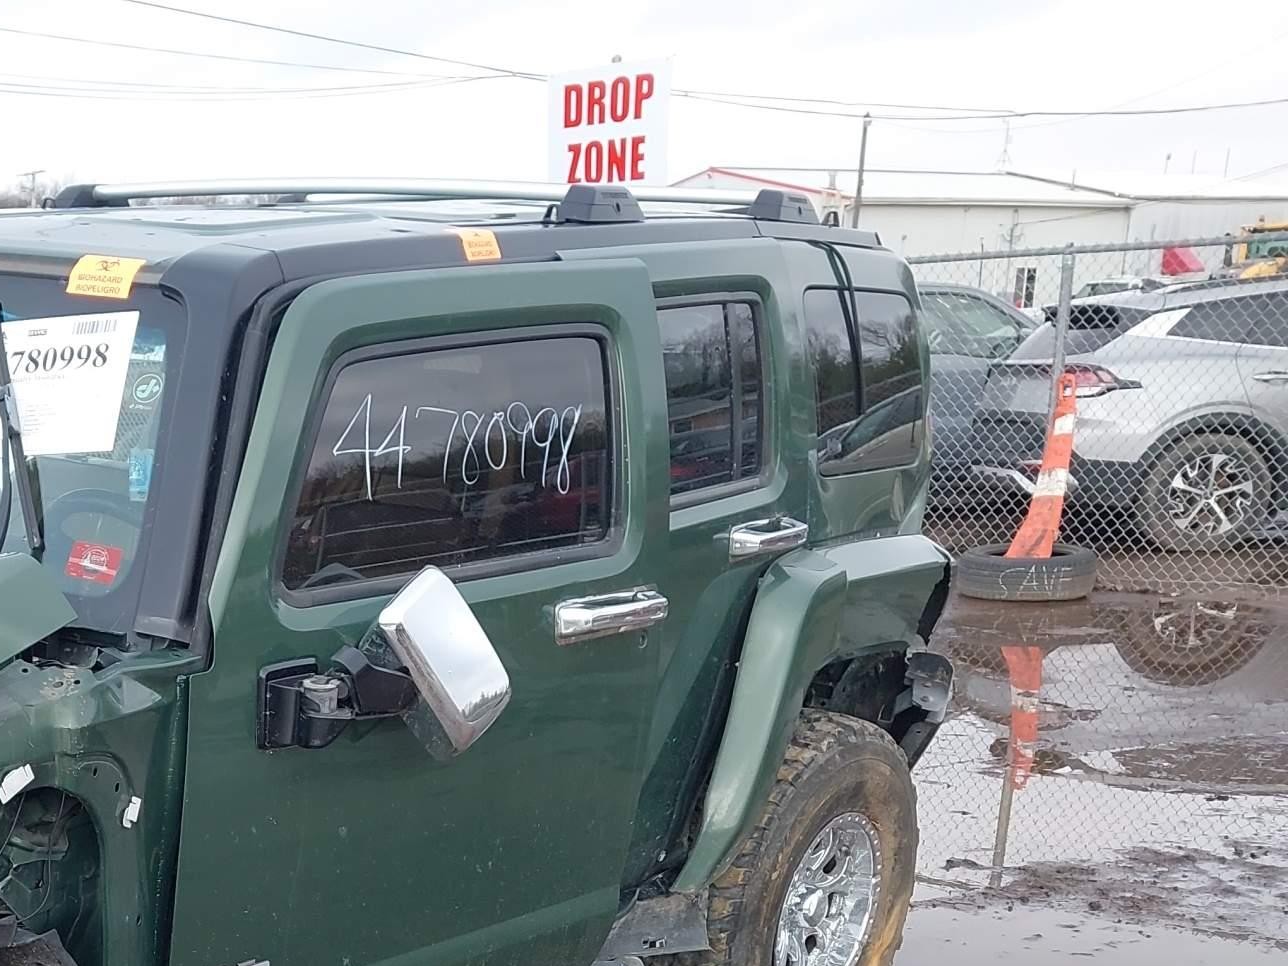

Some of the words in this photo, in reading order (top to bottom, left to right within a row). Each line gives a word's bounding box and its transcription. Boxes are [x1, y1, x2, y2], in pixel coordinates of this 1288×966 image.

[563, 73, 655, 128] DROP
[567, 135, 646, 184] ZONE
[332, 392, 583, 502] 44780998
